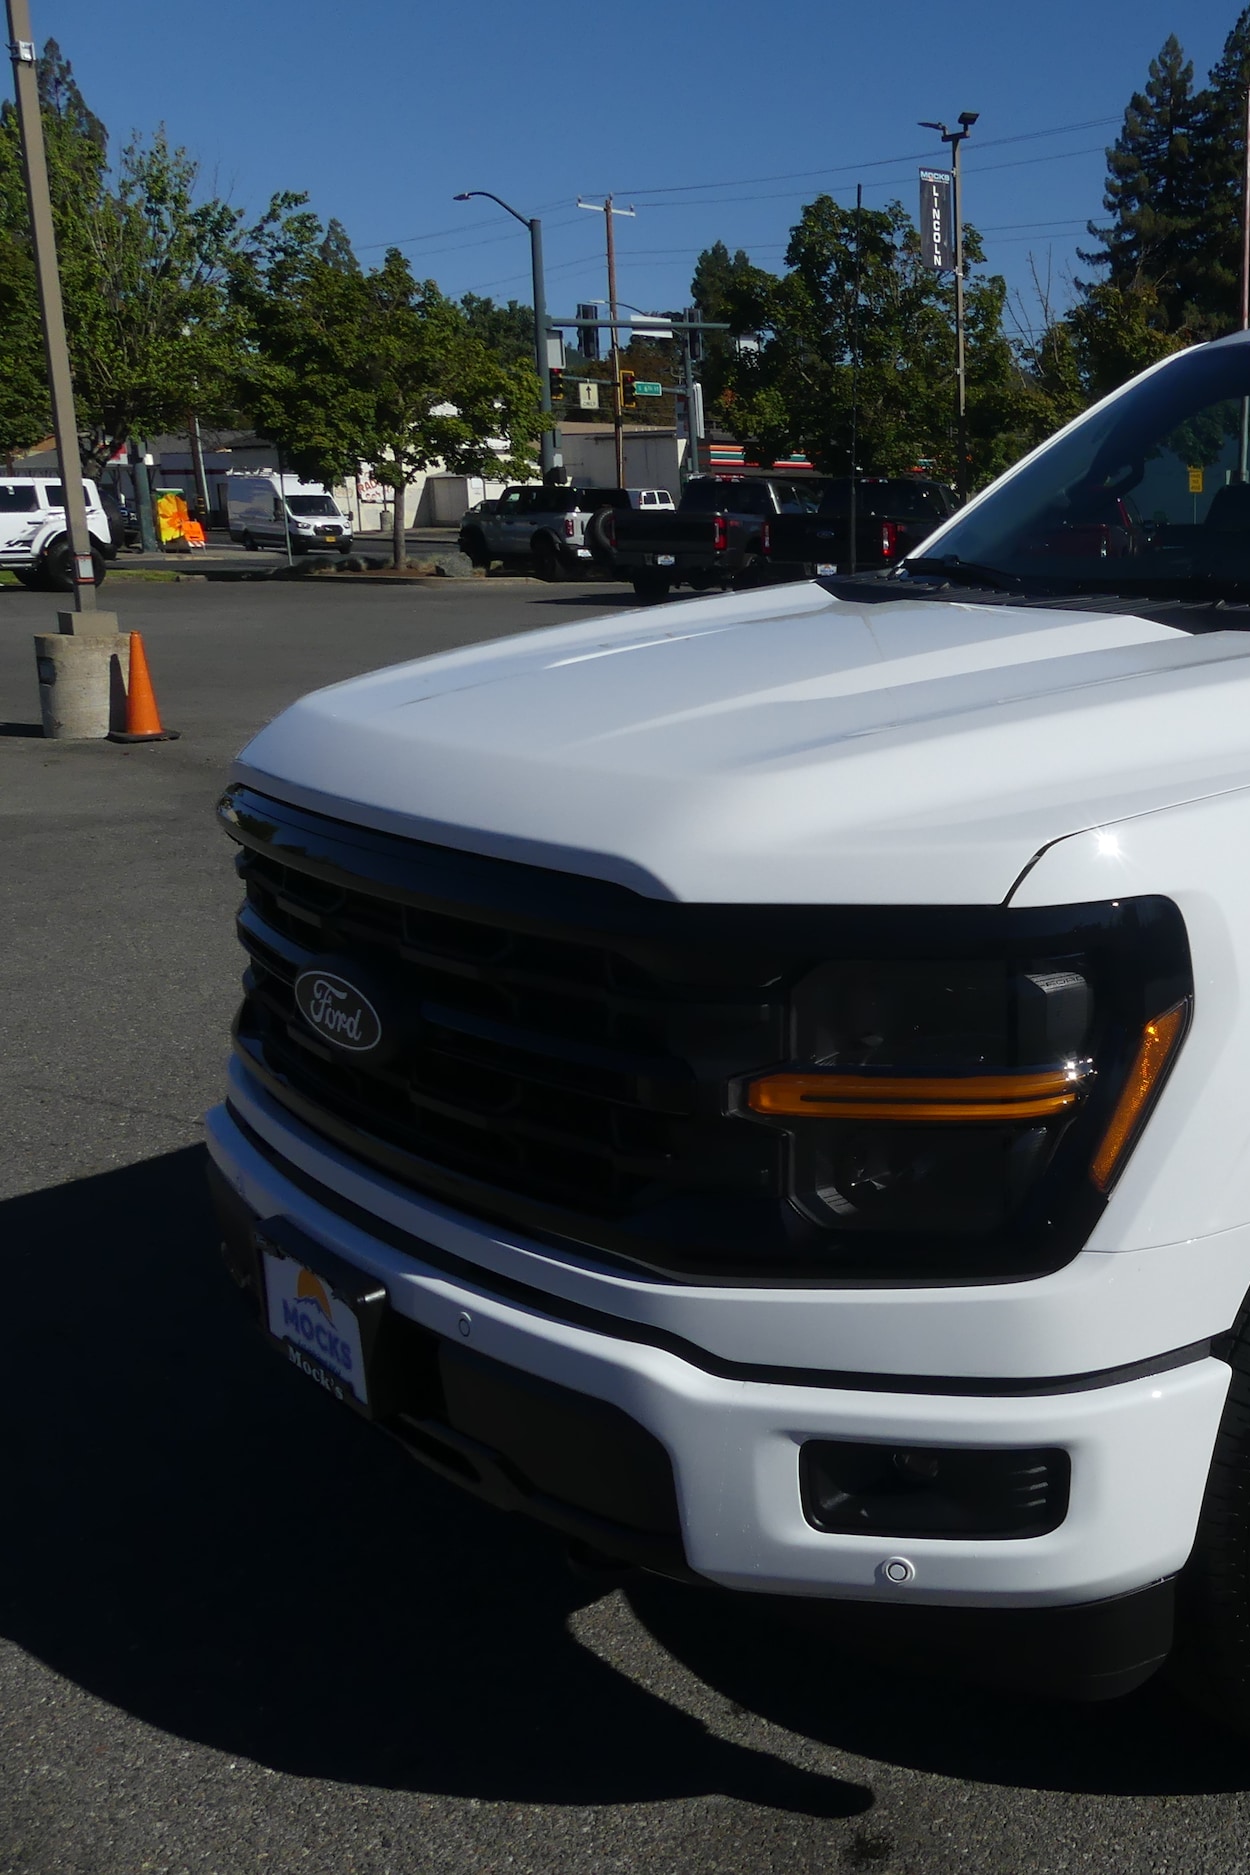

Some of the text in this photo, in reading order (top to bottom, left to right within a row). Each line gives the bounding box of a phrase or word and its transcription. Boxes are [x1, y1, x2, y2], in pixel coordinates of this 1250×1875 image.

[932, 185, 942, 267] LINCOLN
[311, 980, 362, 1040] Ford
[282, 1298, 353, 1370] MOCKS
[287, 1344, 344, 1401] Mock's
